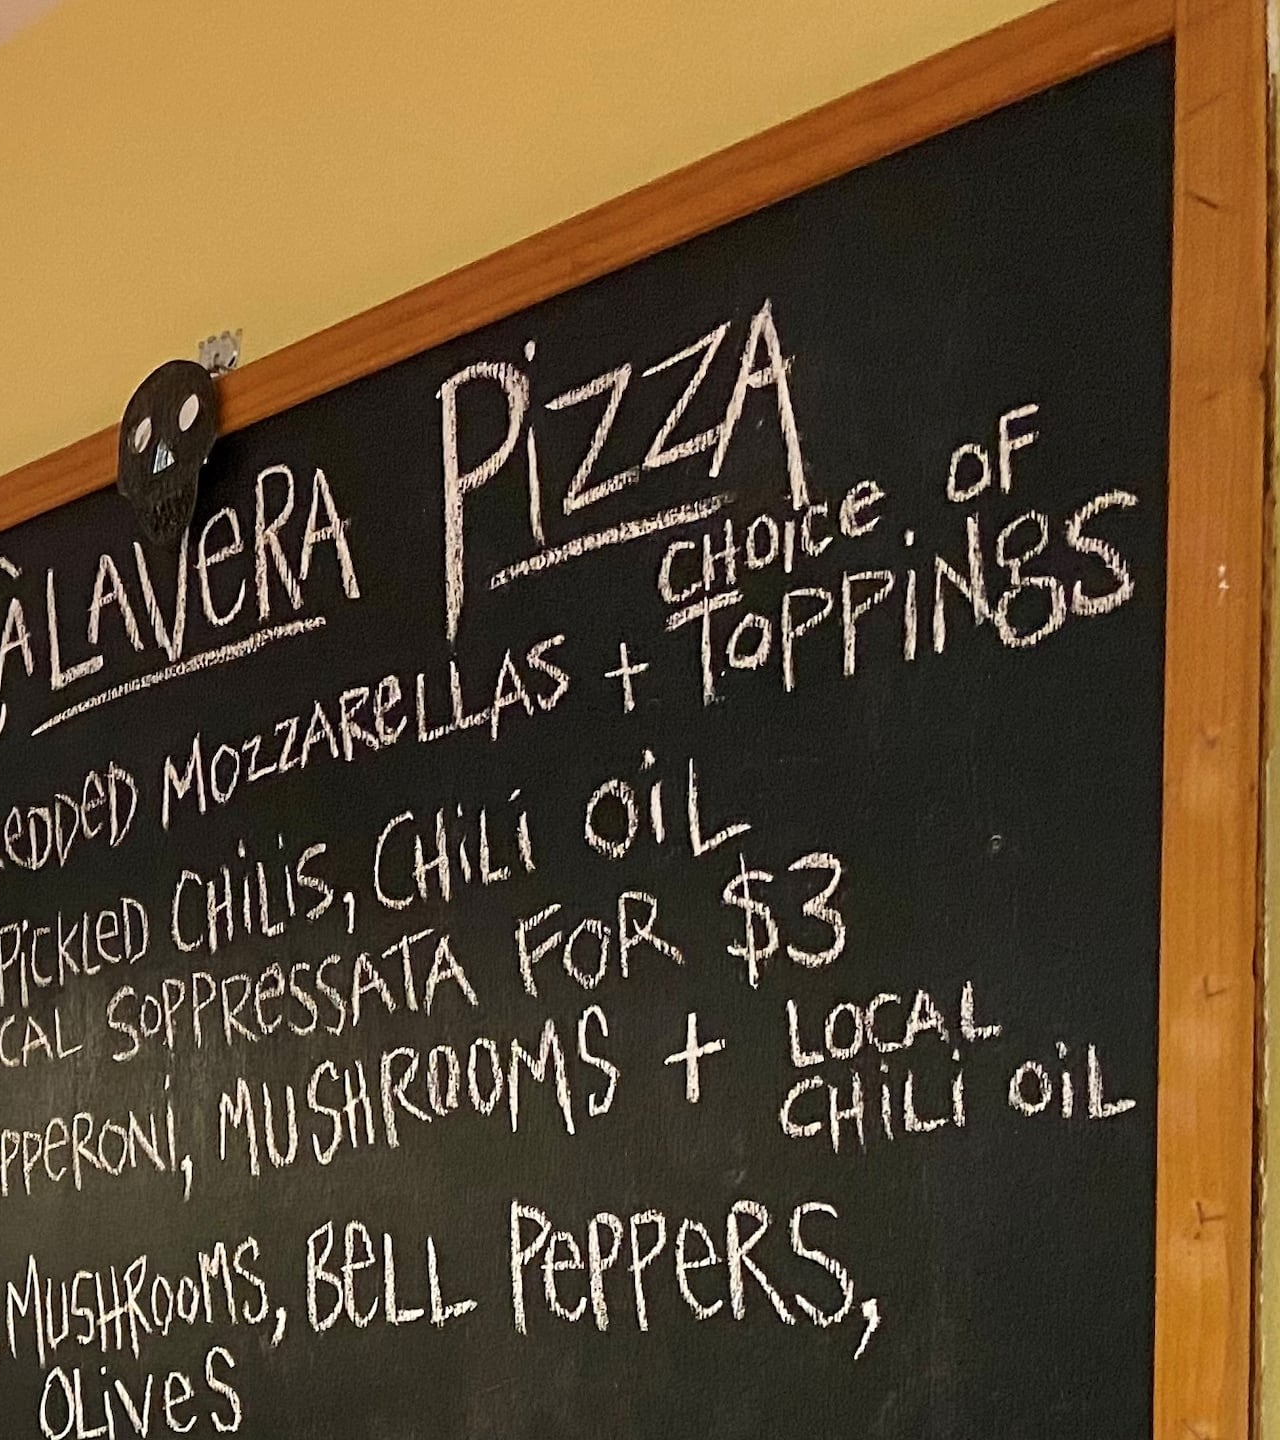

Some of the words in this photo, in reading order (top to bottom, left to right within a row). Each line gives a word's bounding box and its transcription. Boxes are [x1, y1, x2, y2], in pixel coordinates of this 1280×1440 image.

[948, 404, 1039, 502] OF
[163, 634, 571, 831] MOZZAReLLAS
[516, 890, 685, 997] FOR
[722, 851, 847, 991] $3
[219, 1002, 621, 1177] MUSHROOMS
[786, 979, 1002, 1070] LOCAL
